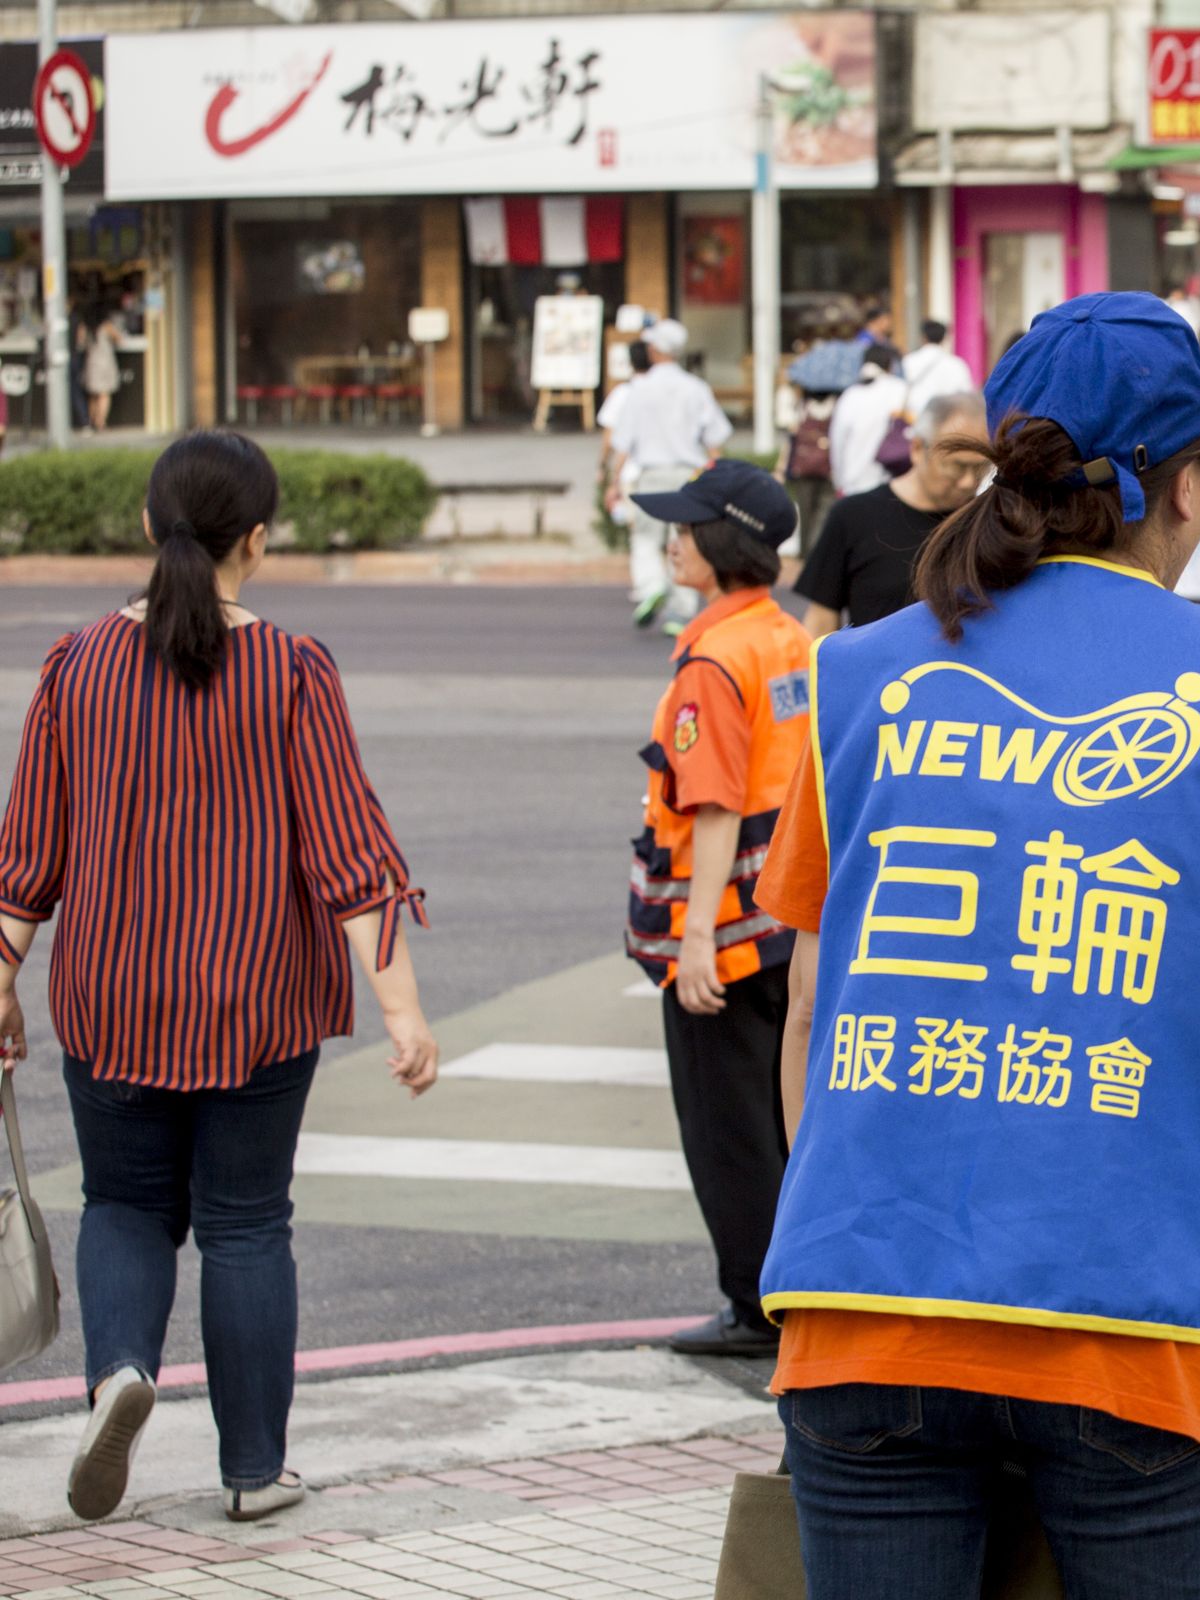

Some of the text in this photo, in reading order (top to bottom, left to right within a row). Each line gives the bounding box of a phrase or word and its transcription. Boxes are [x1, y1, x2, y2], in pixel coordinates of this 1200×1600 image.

[341, 40, 600, 145] 梅光軒
[874, 720, 1068, 784] NEW
[849, 825, 1180, 1005] 巨輪
[828, 1013, 1152, 1118] 服務協會
